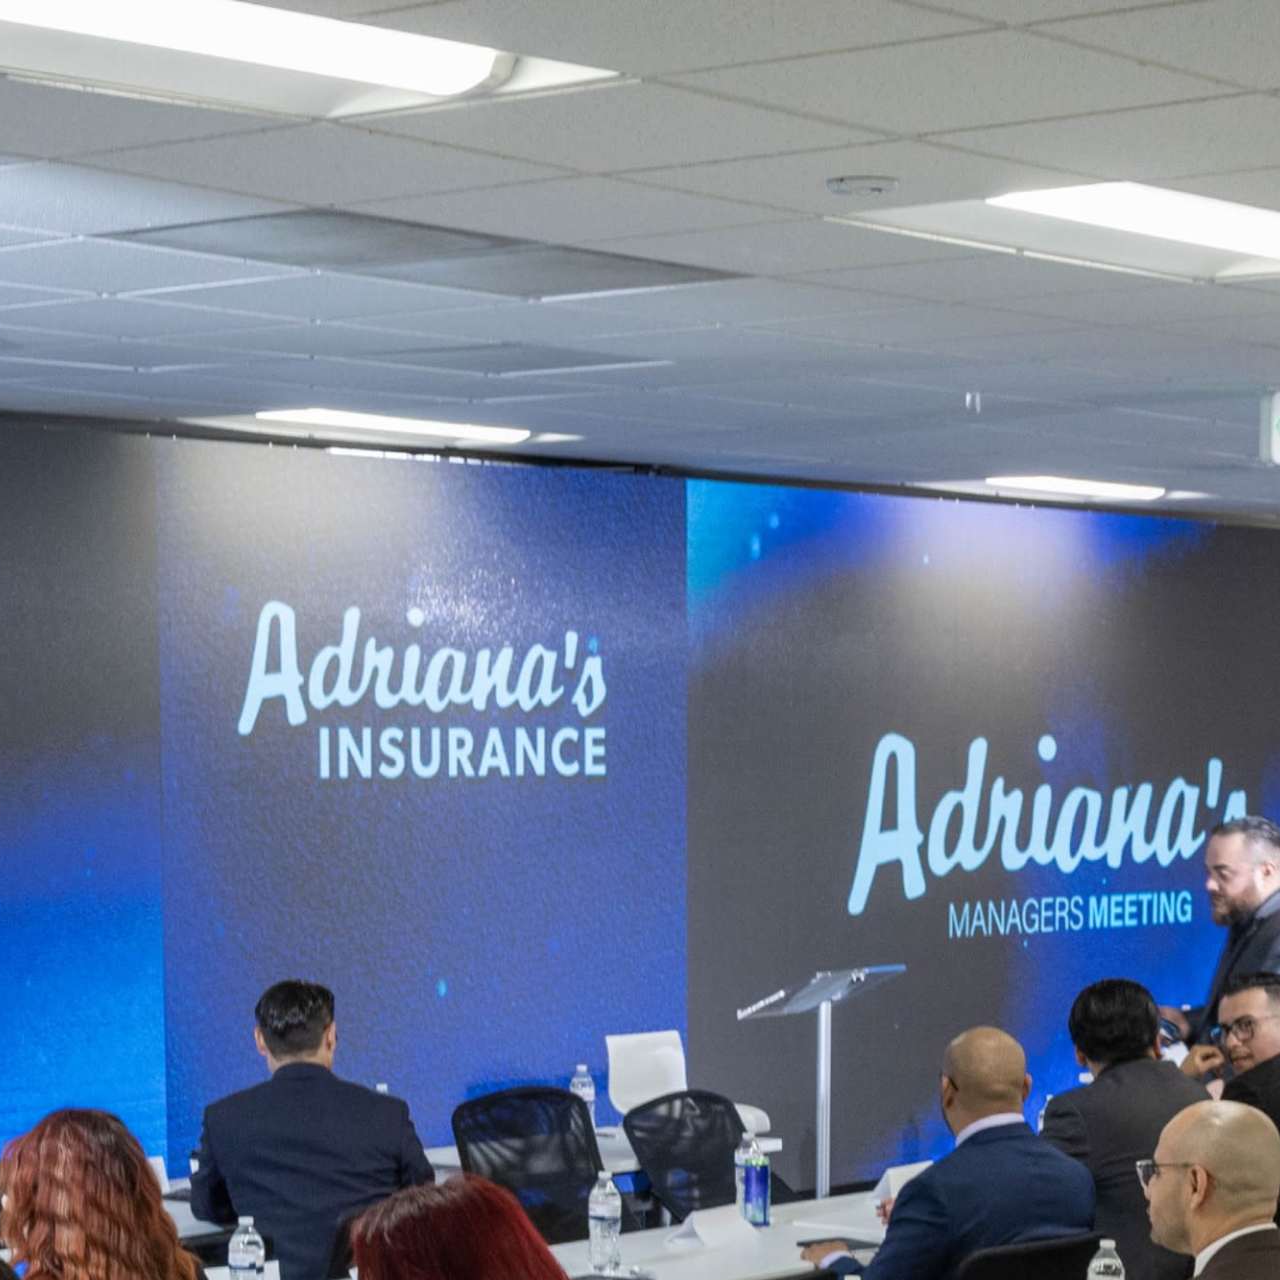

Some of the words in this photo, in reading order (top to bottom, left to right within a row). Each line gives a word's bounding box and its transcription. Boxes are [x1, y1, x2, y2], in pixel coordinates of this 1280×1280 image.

[237, 600, 607, 736] Adriana's
[320, 726, 607, 780] INSURANCE
[948, 896, 1084, 939] MANAGERS
[1088, 890, 1193, 929] MEETING
